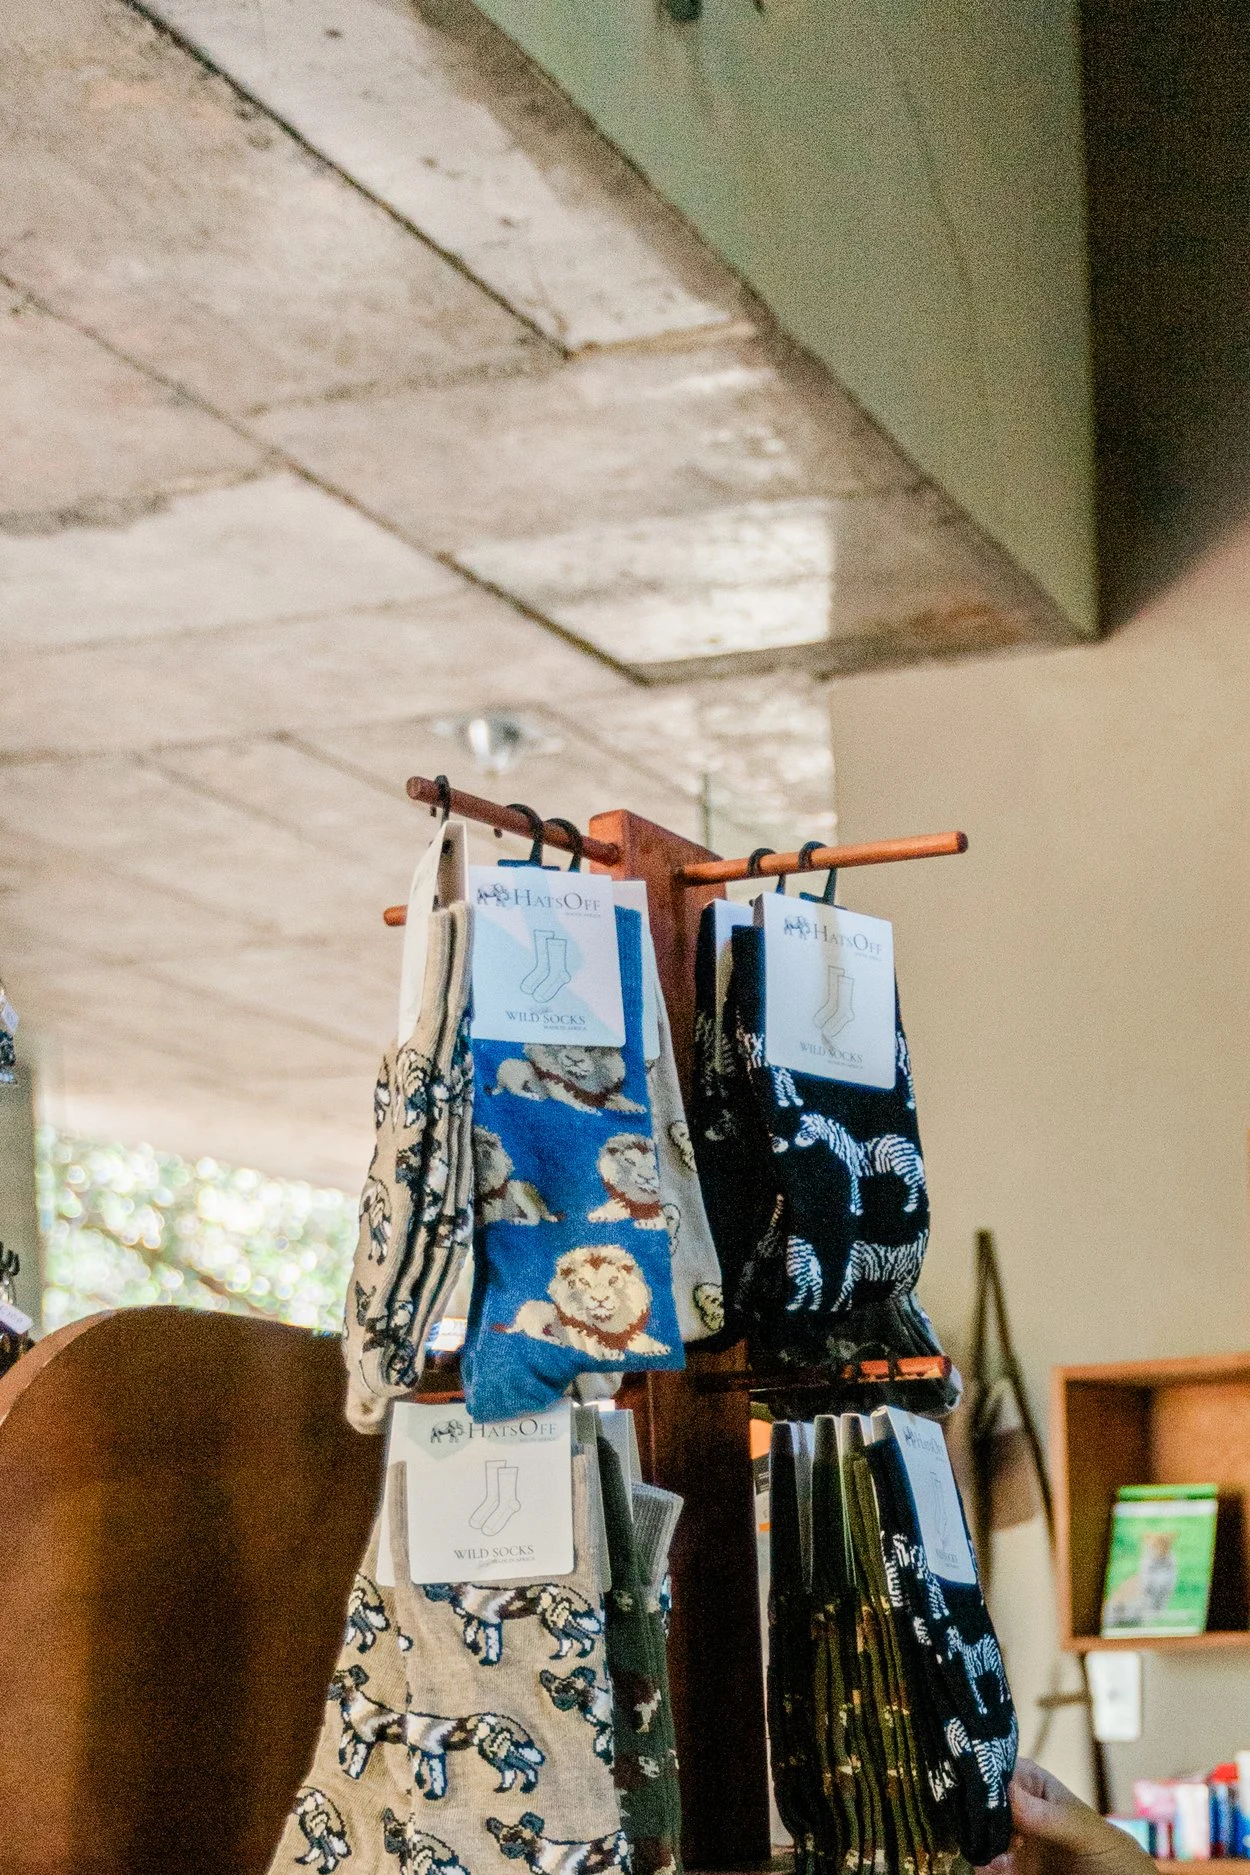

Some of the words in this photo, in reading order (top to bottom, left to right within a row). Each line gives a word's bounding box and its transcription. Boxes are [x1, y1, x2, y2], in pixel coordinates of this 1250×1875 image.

[505, 1010, 540, 1024] WILD
[542, 1014, 586, 1025] SOCKS
[799, 1041, 826, 1057] WILD
[453, 1547, 489, 1560] WILD
[492, 1544, 535, 1557] SOCKS
